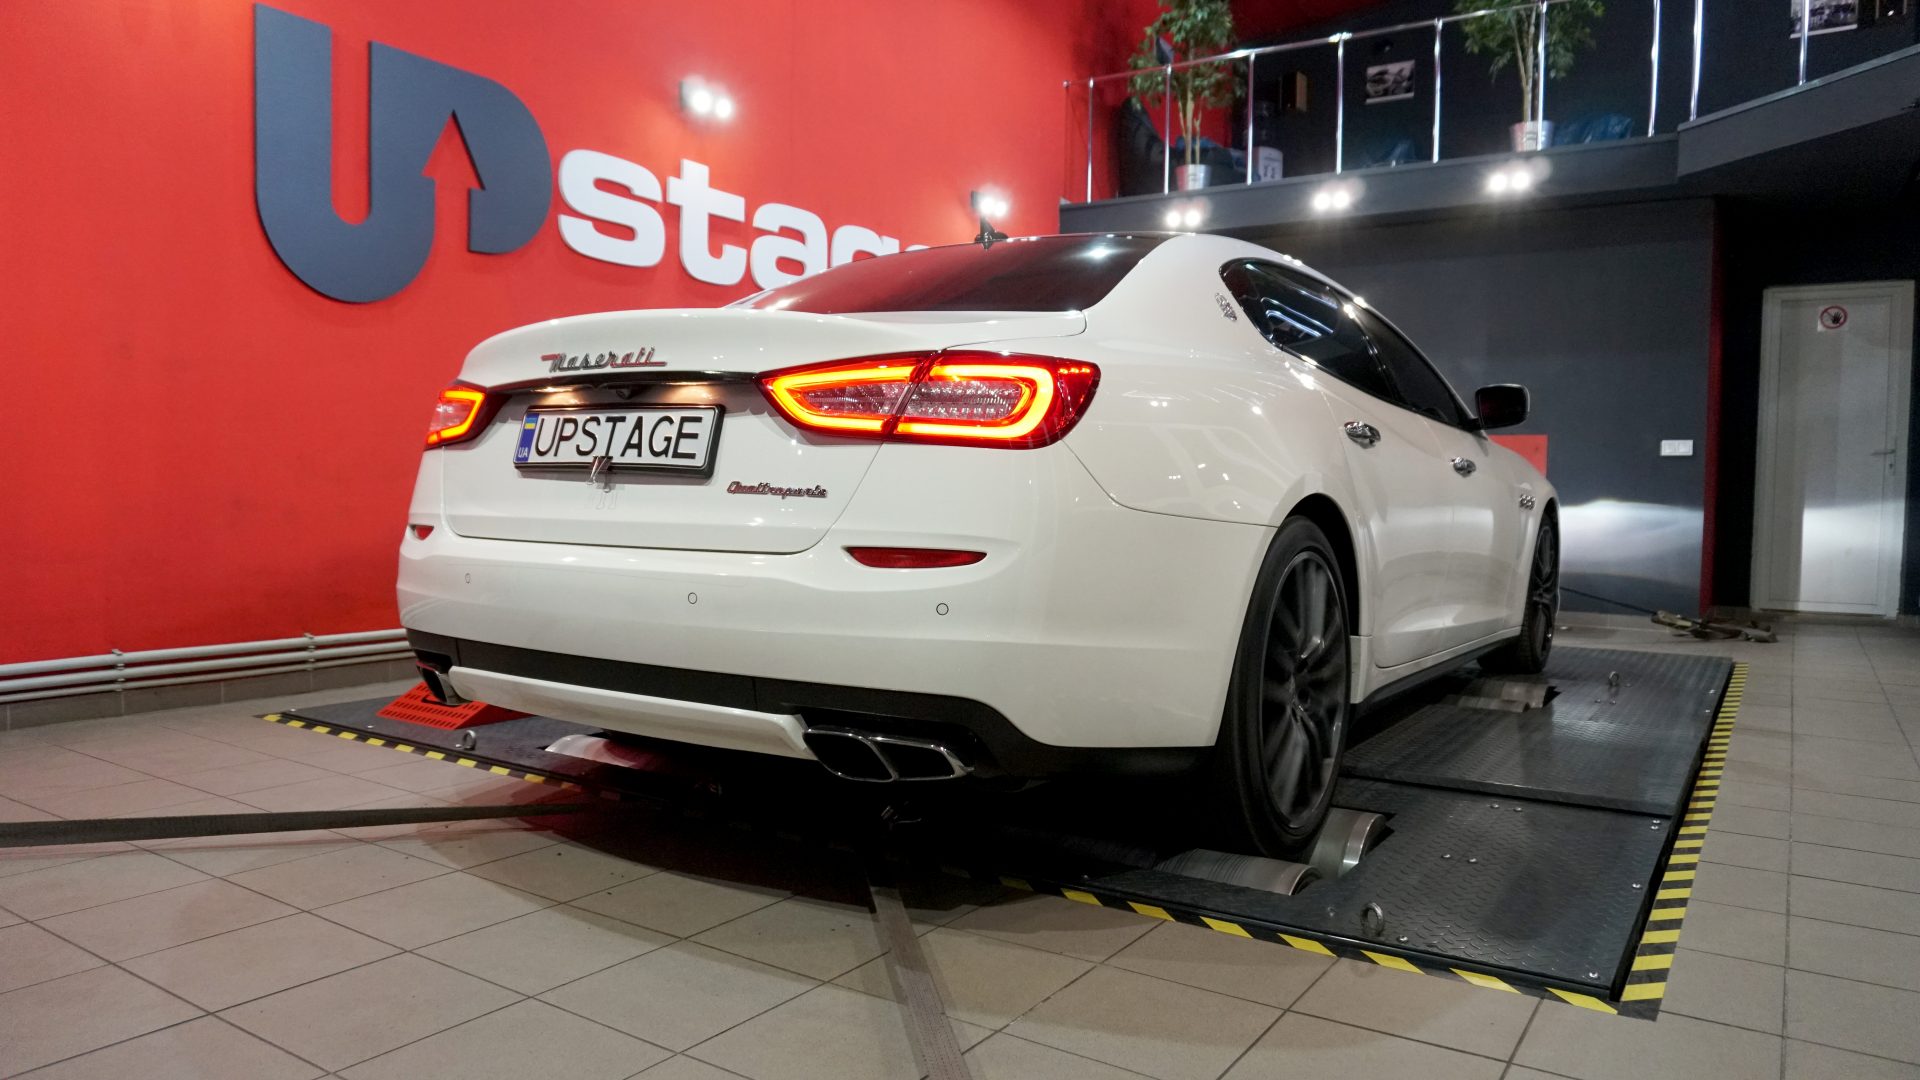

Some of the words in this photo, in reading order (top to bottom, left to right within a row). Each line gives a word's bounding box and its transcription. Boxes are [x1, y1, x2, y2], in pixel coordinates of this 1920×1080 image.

[541, 347, 667, 373] Maserati
[517, 446, 529, 458] UA
[535, 415, 703, 459] UPSTAGE
